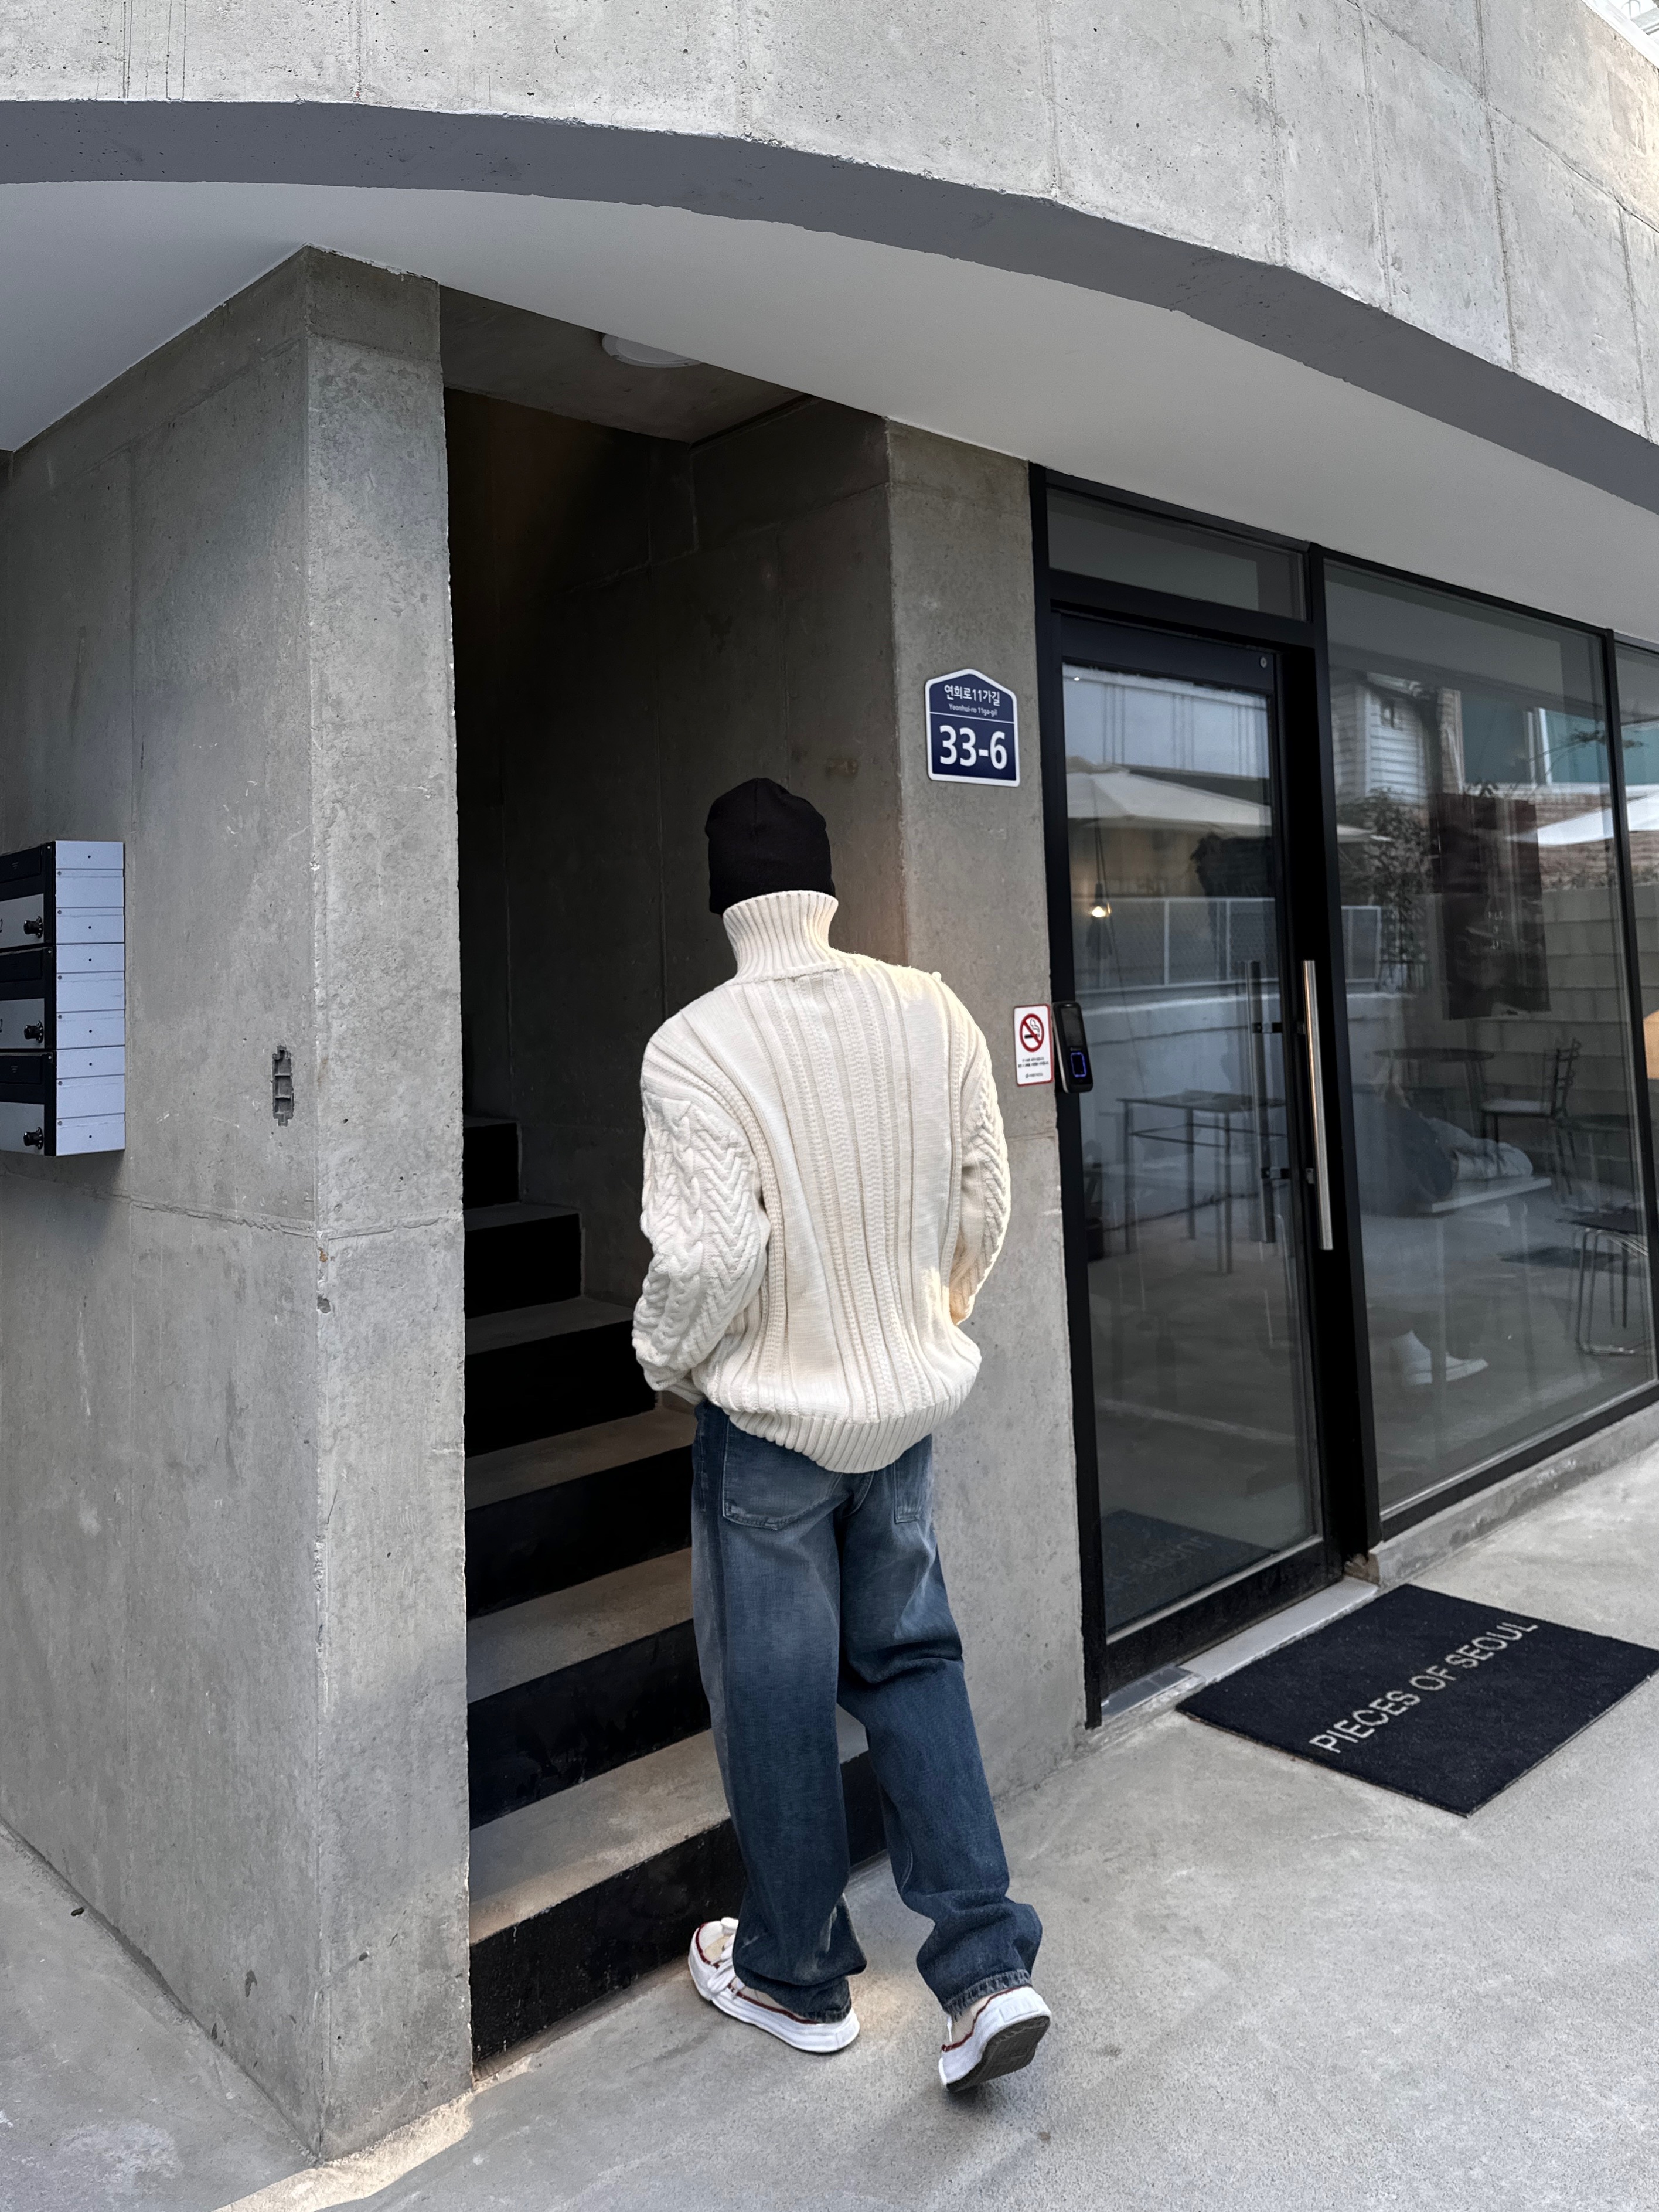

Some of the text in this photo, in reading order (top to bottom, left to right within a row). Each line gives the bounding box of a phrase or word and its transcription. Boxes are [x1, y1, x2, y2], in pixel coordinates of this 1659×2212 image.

[944, 685, 1000, 706] 연희로11가길
[948, 703, 998, 717] Yeonhui-ro 11ga-gil
[939, 725, 1008, 770] 33-6
[1309, 1622, 1539, 1754] PIECES OF SEOUL
